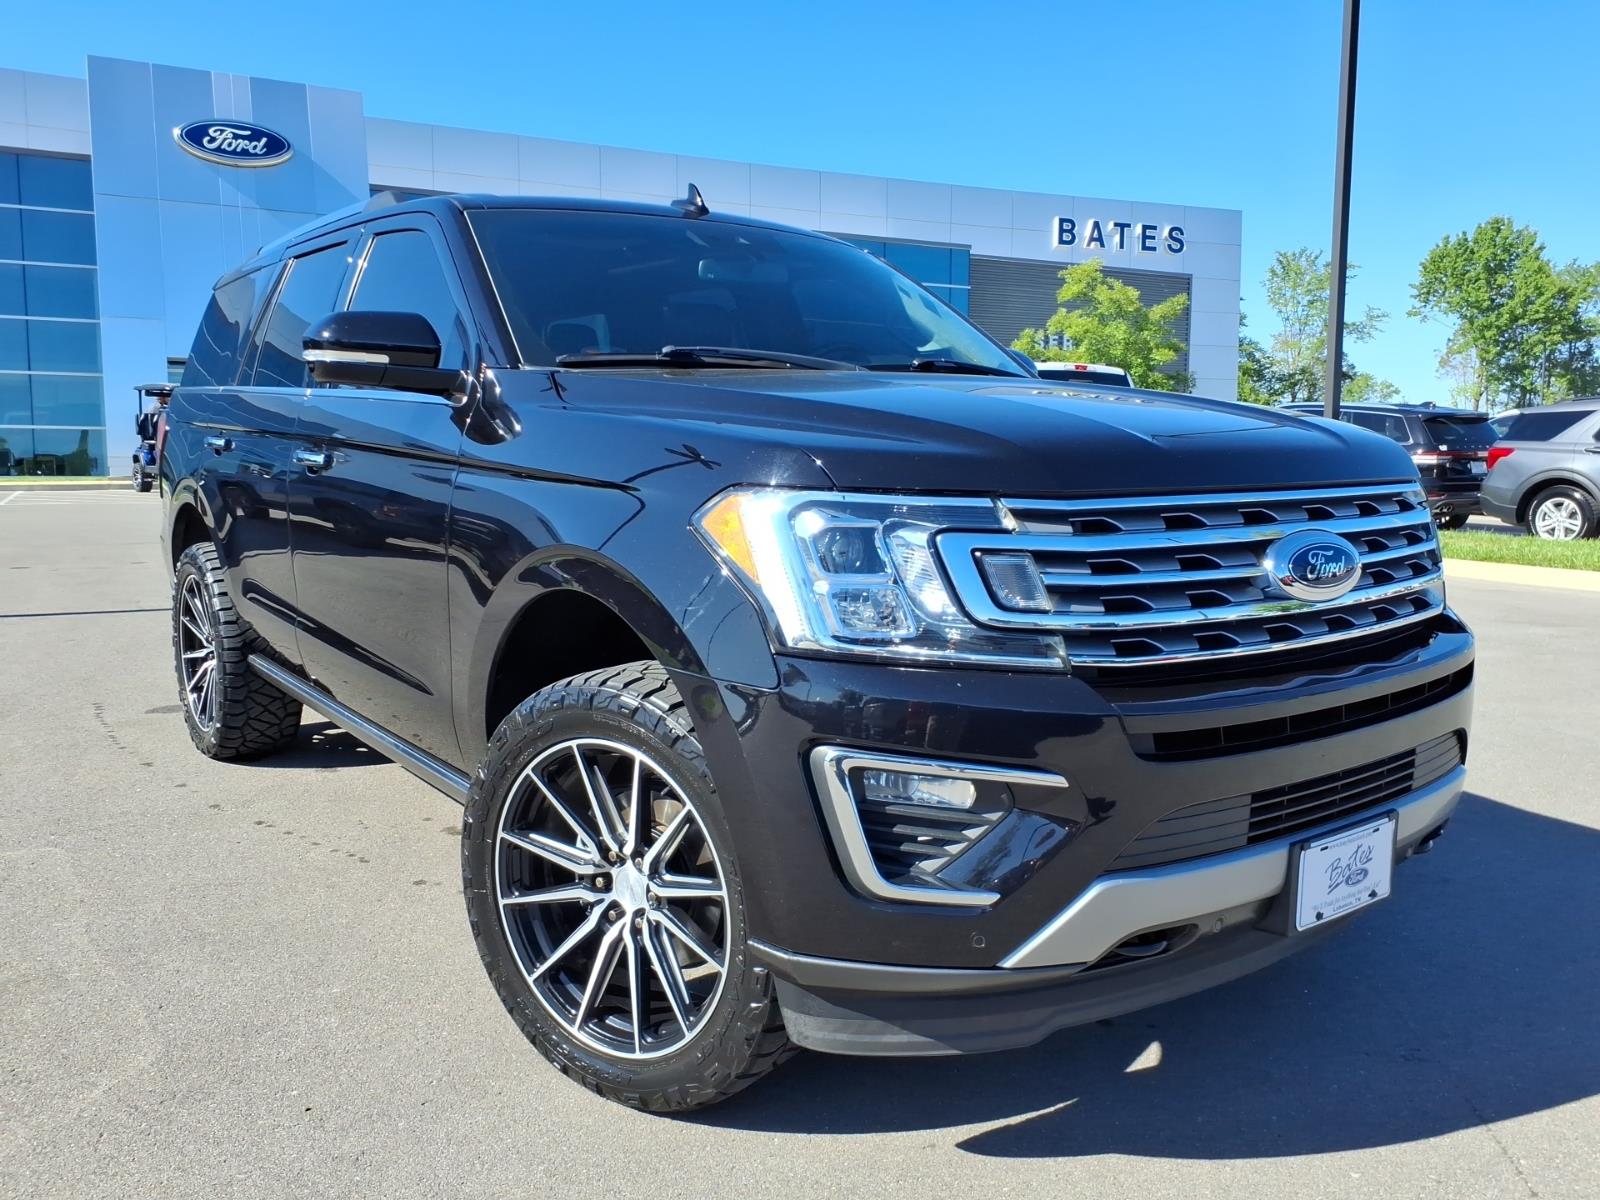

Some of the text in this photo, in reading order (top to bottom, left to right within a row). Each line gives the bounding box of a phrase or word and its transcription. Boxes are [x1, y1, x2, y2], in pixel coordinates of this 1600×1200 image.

[203, 126, 267, 155] Ford
[1053, 216, 1186, 254] BATES
[1307, 550, 1345, 580] Ford
